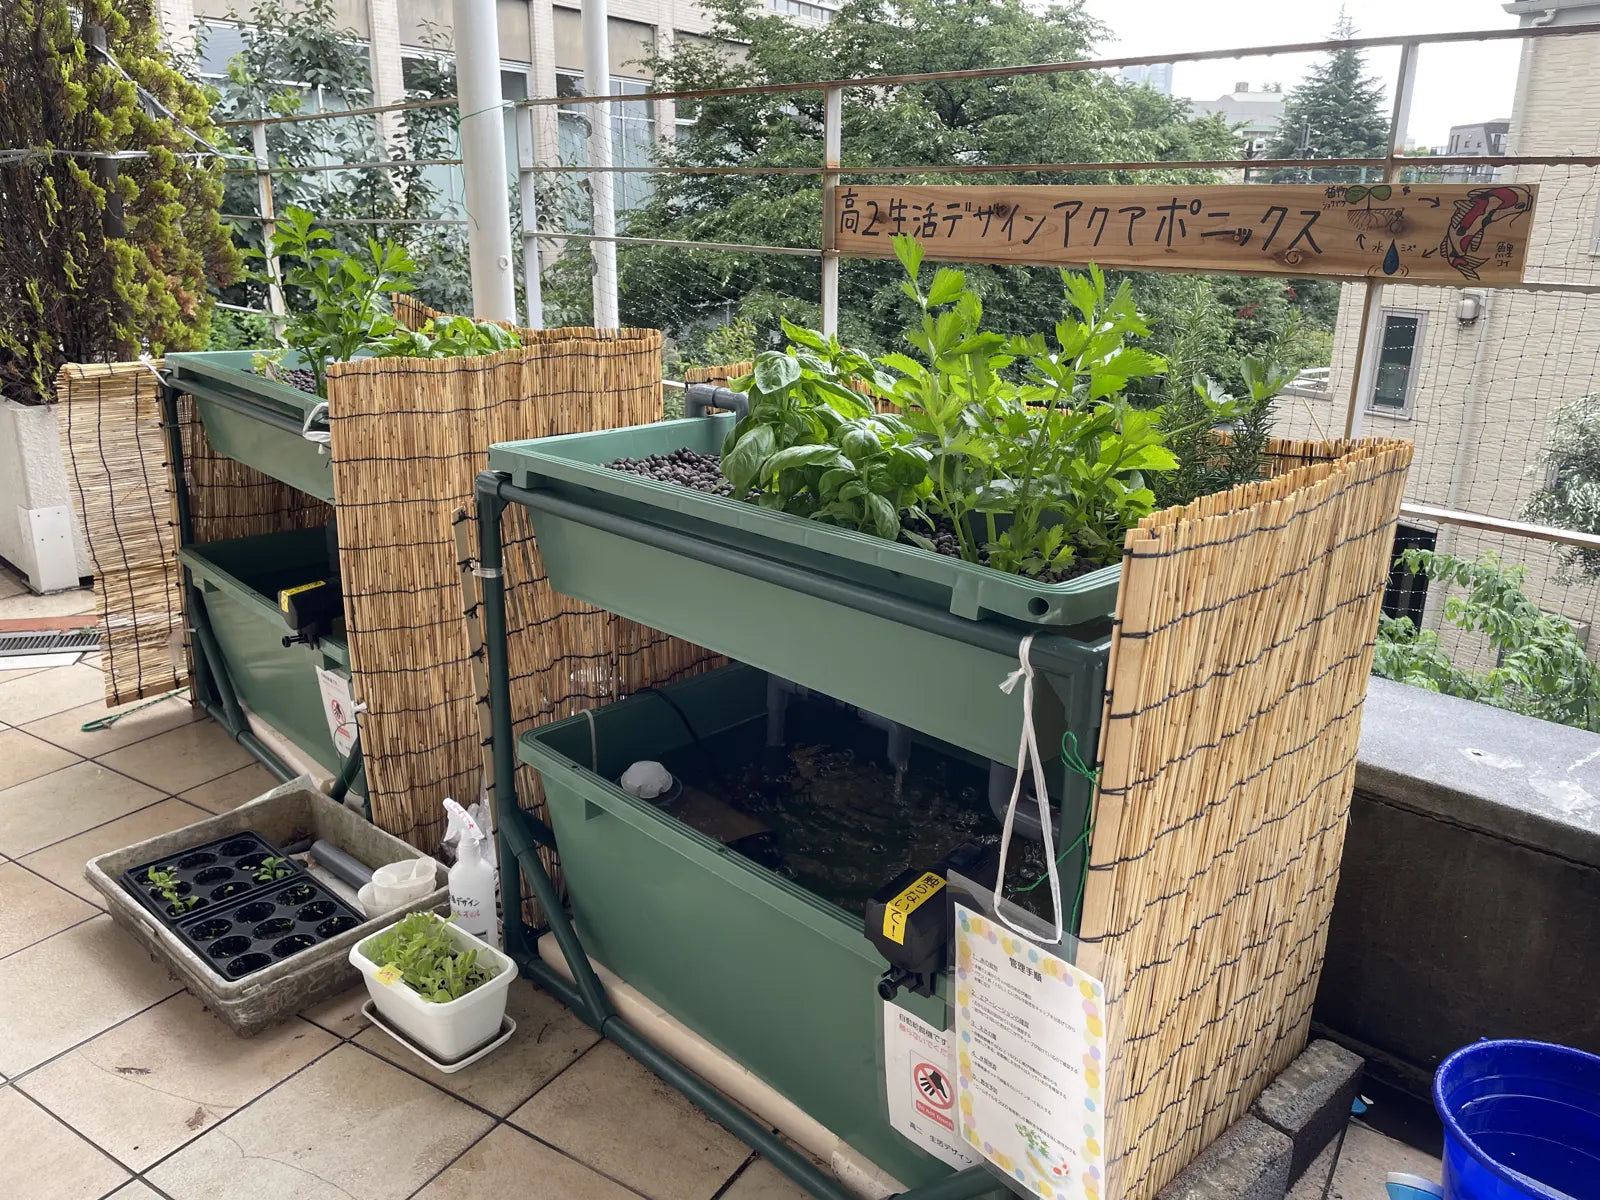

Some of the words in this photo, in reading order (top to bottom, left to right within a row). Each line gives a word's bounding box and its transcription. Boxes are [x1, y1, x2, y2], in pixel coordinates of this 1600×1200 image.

[1372, 241, 1385, 253] 水
[1494, 241, 1514, 259] 鯉
[1496, 259, 1510, 268] コイ
[1009, 957, 1043, 983] 管理手順
